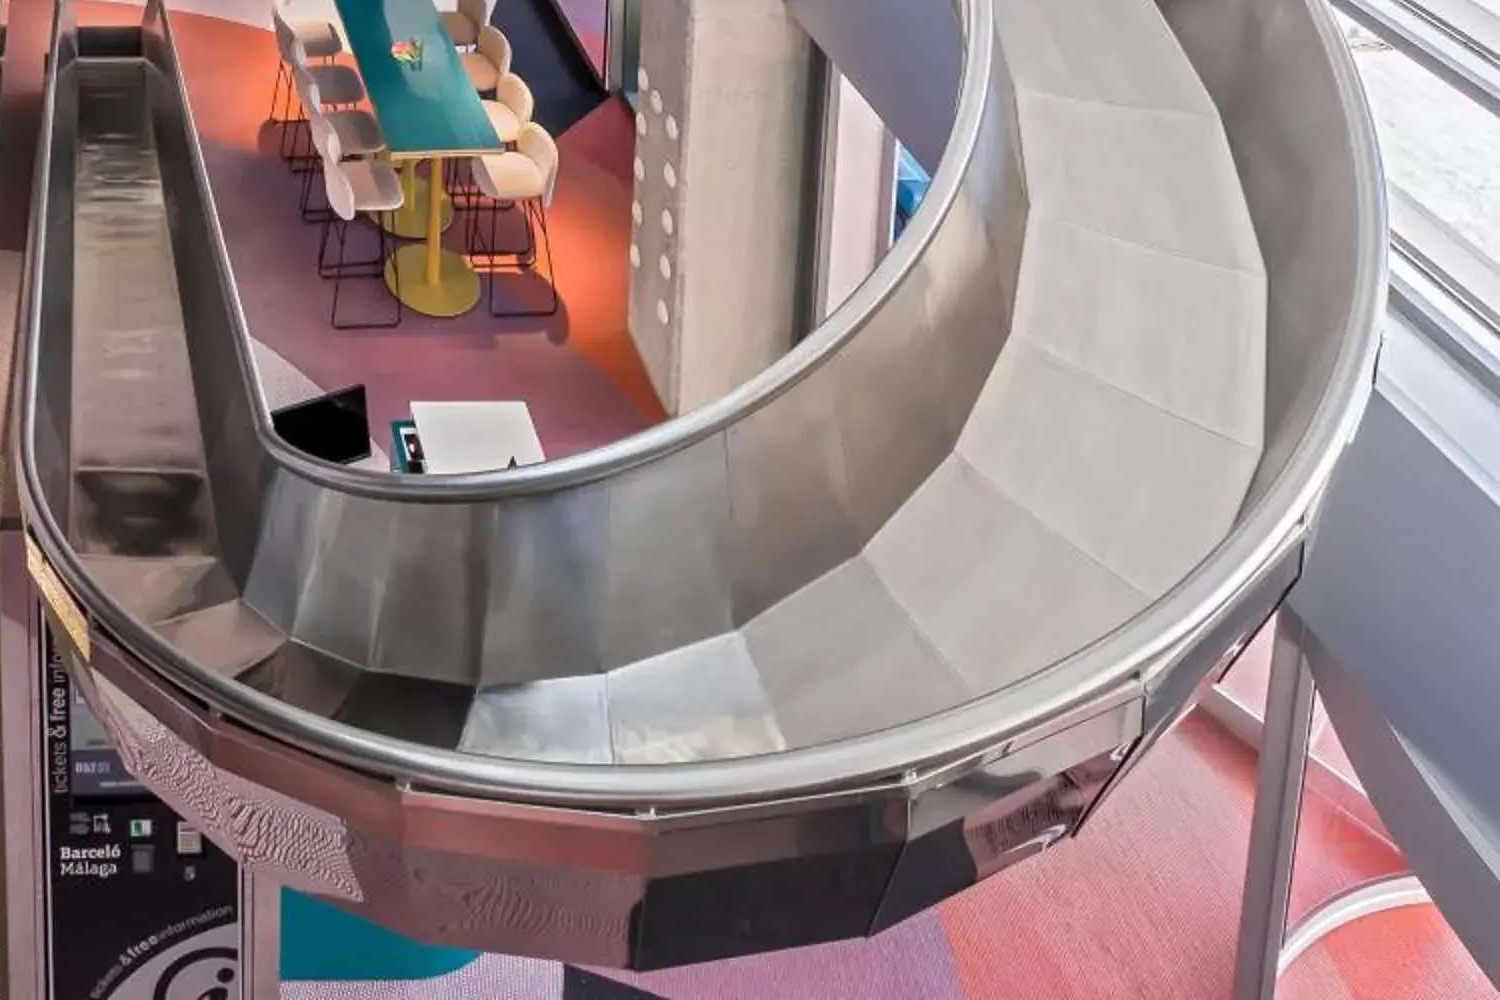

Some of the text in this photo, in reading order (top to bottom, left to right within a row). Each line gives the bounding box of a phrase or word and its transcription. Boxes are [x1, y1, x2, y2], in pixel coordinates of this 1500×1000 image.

[50, 688, 67, 721] free
[47, 725, 67, 739] &
[52, 741, 68, 793] tickets
[60, 844, 121, 859] Barceló
[60, 862, 118, 877] Málaga
[126, 935, 159, 959] free
